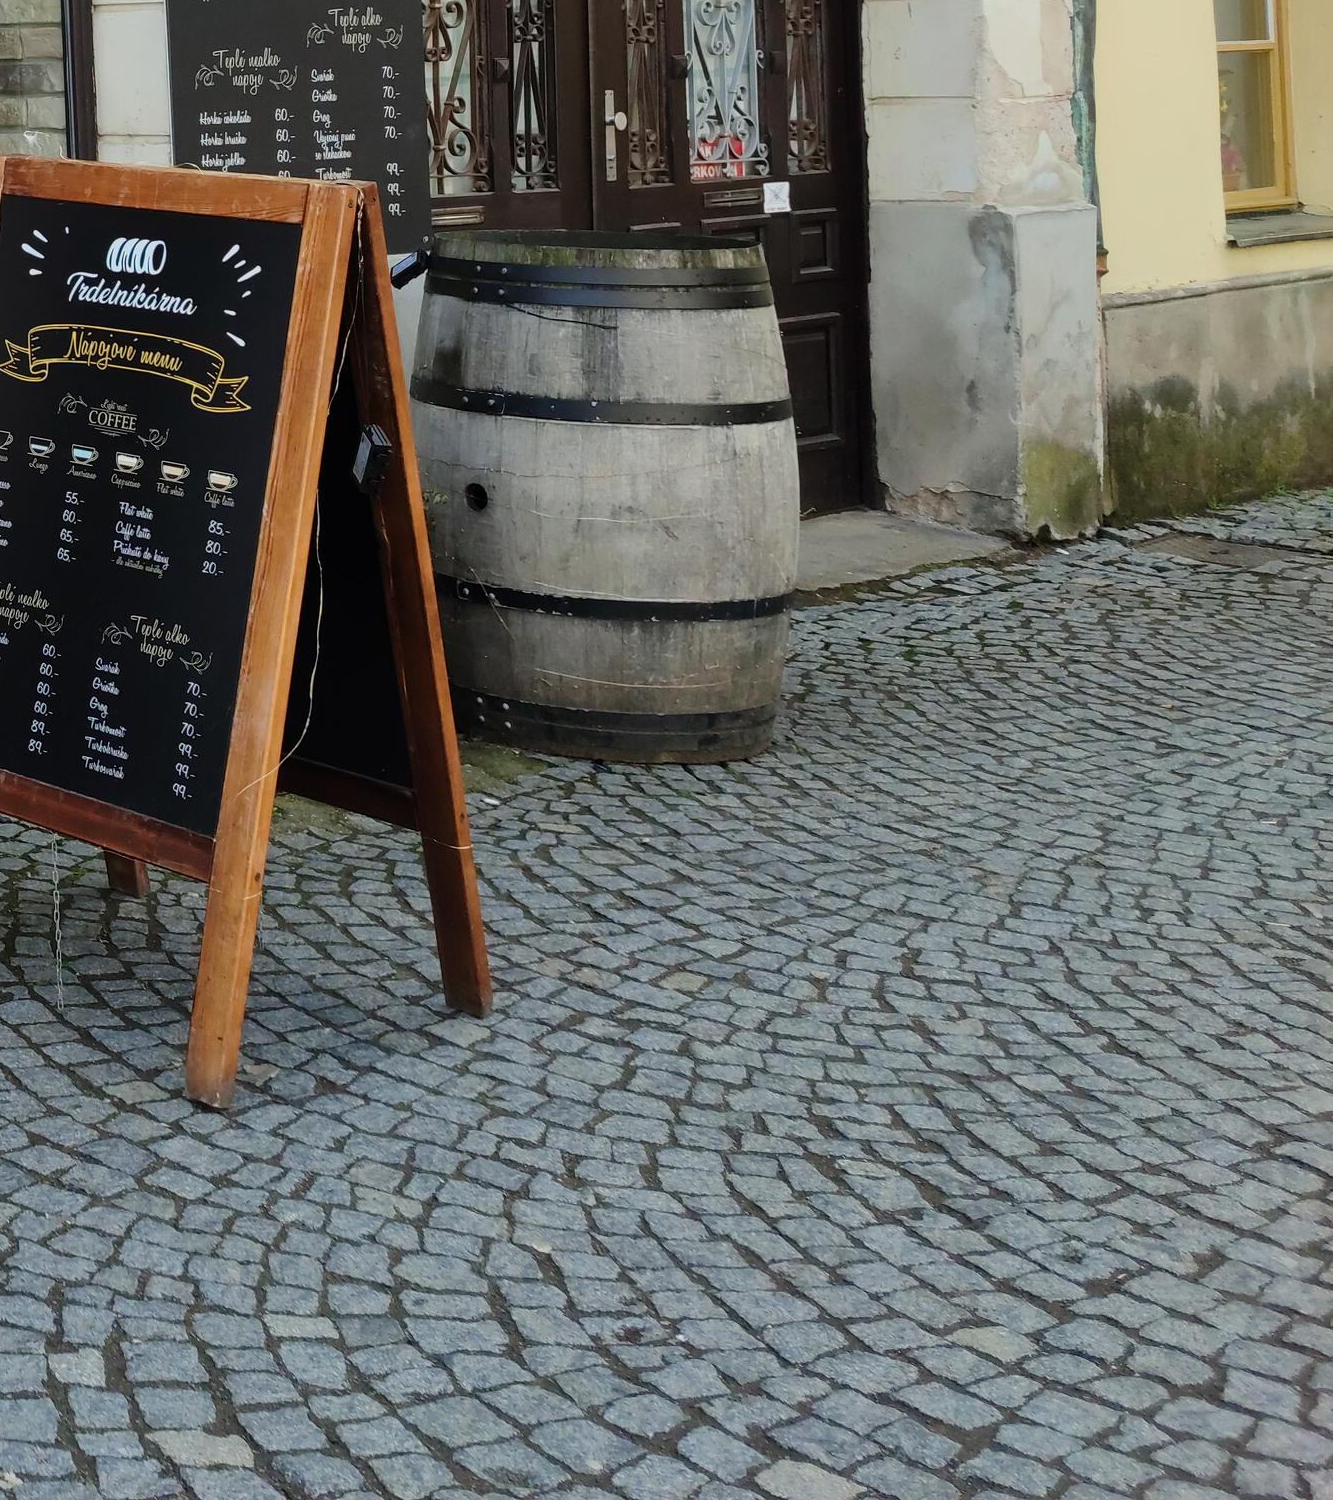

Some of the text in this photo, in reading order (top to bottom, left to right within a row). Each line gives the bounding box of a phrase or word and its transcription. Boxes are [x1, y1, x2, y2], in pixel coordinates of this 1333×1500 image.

[213, 48, 246, 76] Teplé
[313, 109, 331, 128] Grog
[66, 271, 197, 315] Trdelníkárna
[63, 330, 183, 372] Nápojové menu
[88, 410, 137, 432] COFFEE
[130, 615, 191, 645] Teplé alko
[89, 696, 109, 718] Grog
